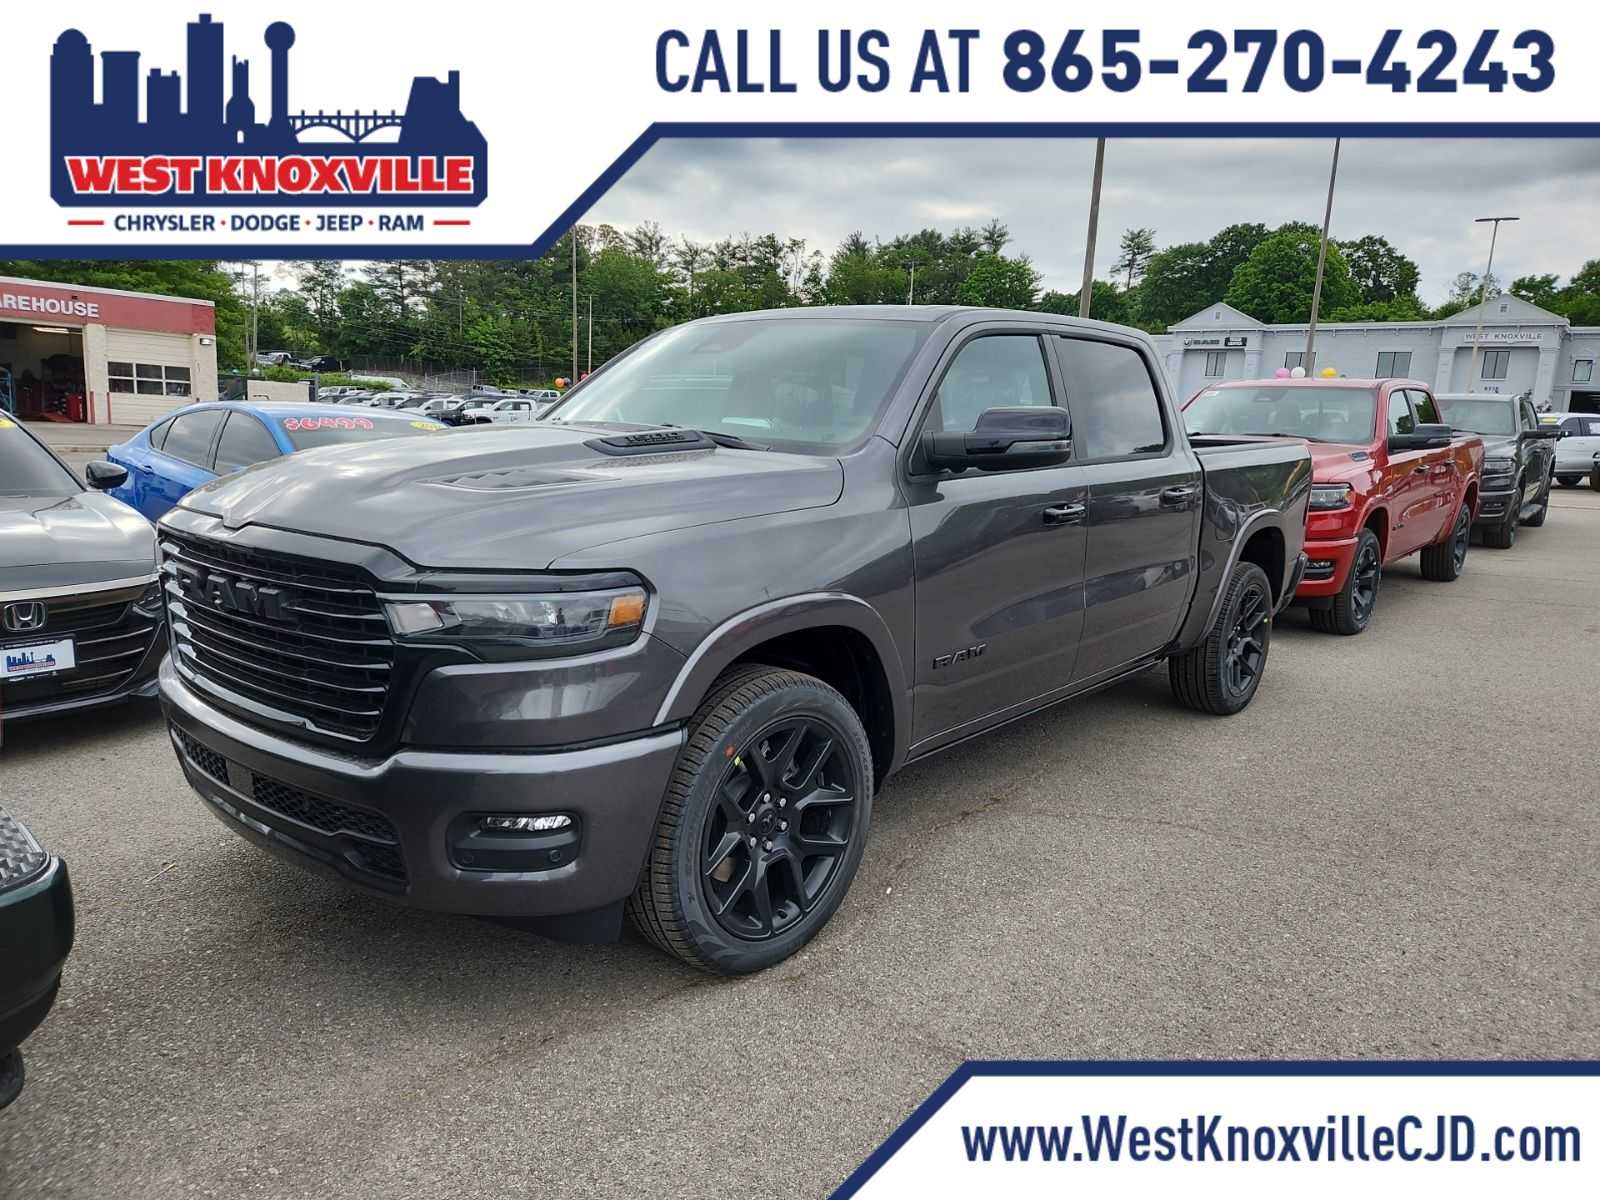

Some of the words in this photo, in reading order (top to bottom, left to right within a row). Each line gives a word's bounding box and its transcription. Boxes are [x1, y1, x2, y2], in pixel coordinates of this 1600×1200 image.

[0, 293, 99, 318] REHOUSE
[175, 560, 281, 619] RAM
[932, 643, 987, 670] RAM
